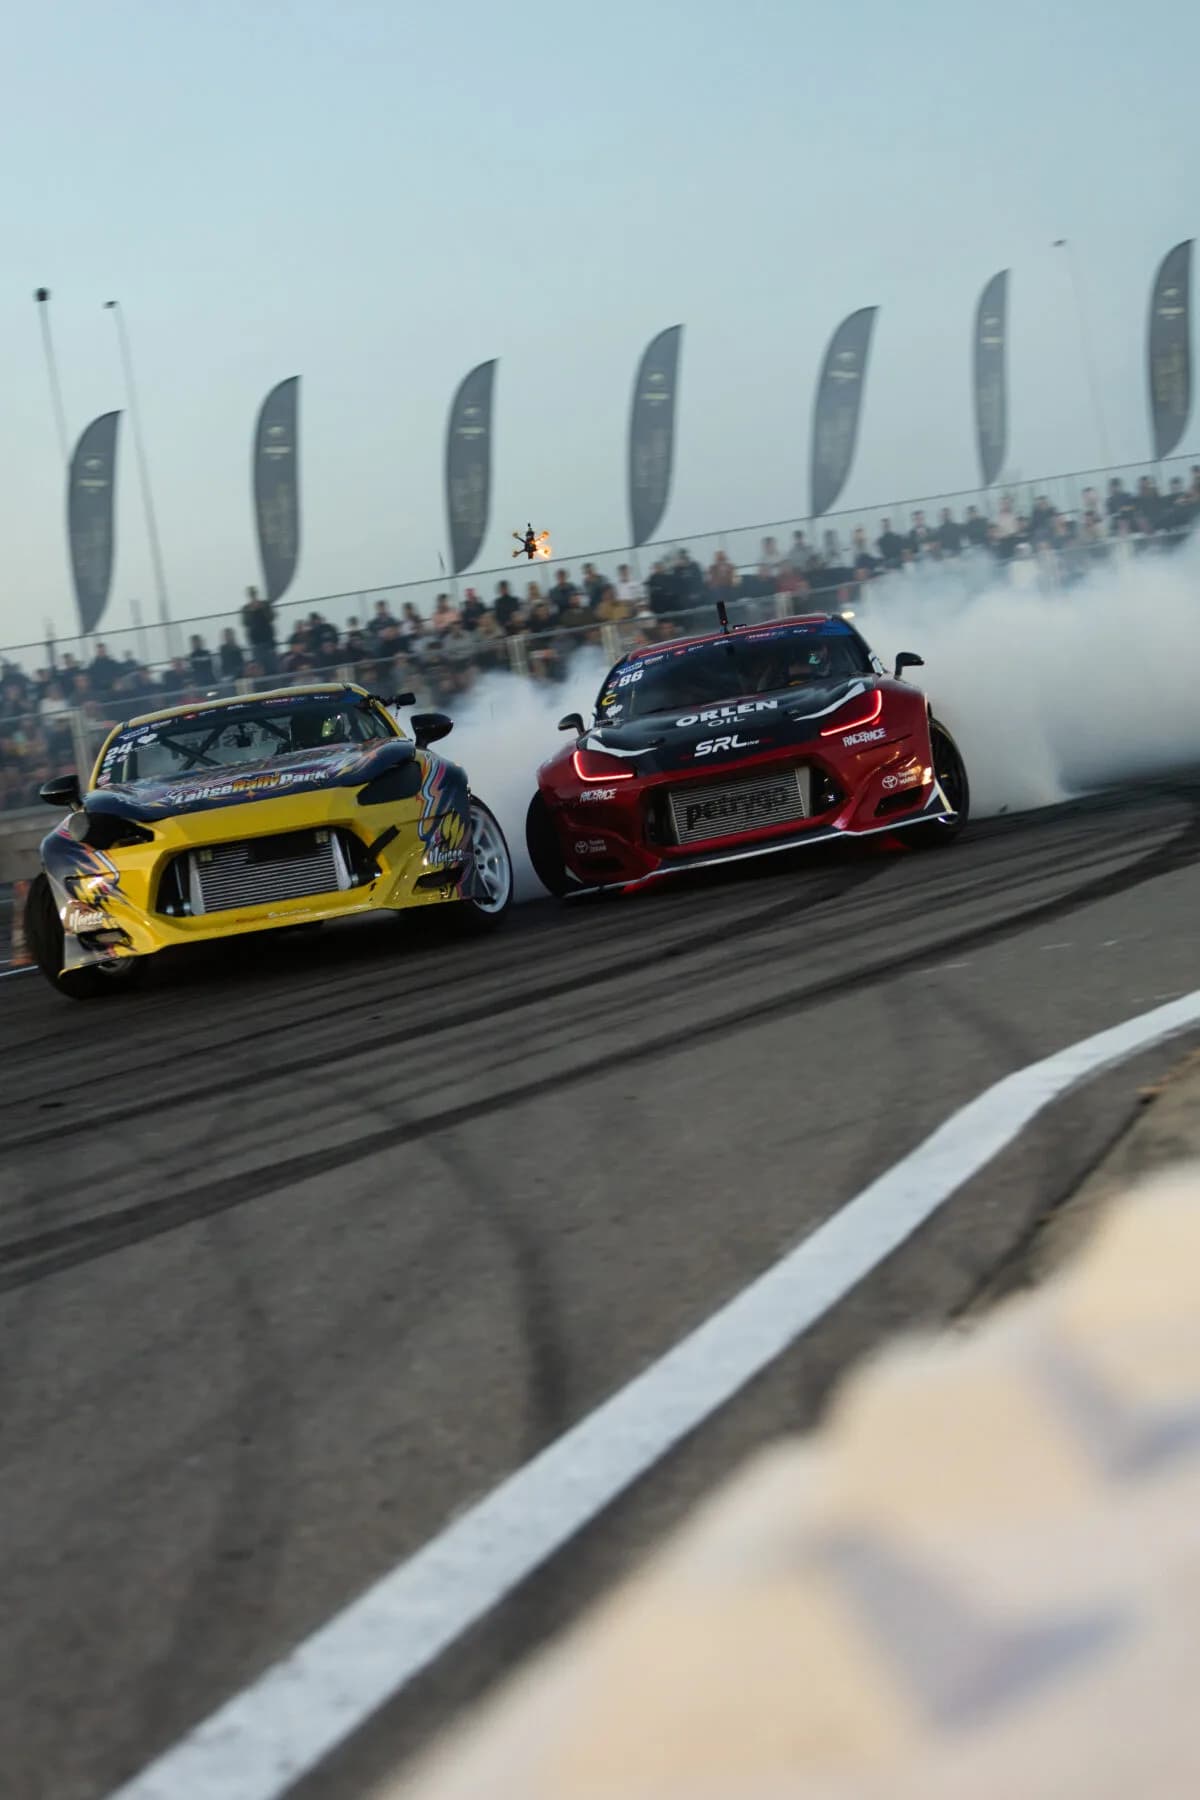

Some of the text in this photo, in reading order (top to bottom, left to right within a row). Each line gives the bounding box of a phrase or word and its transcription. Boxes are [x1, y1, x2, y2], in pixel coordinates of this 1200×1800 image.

[676, 700, 778, 727] ORLEN
[708, 716, 744, 727] OIL
[104, 741, 133, 761] 24
